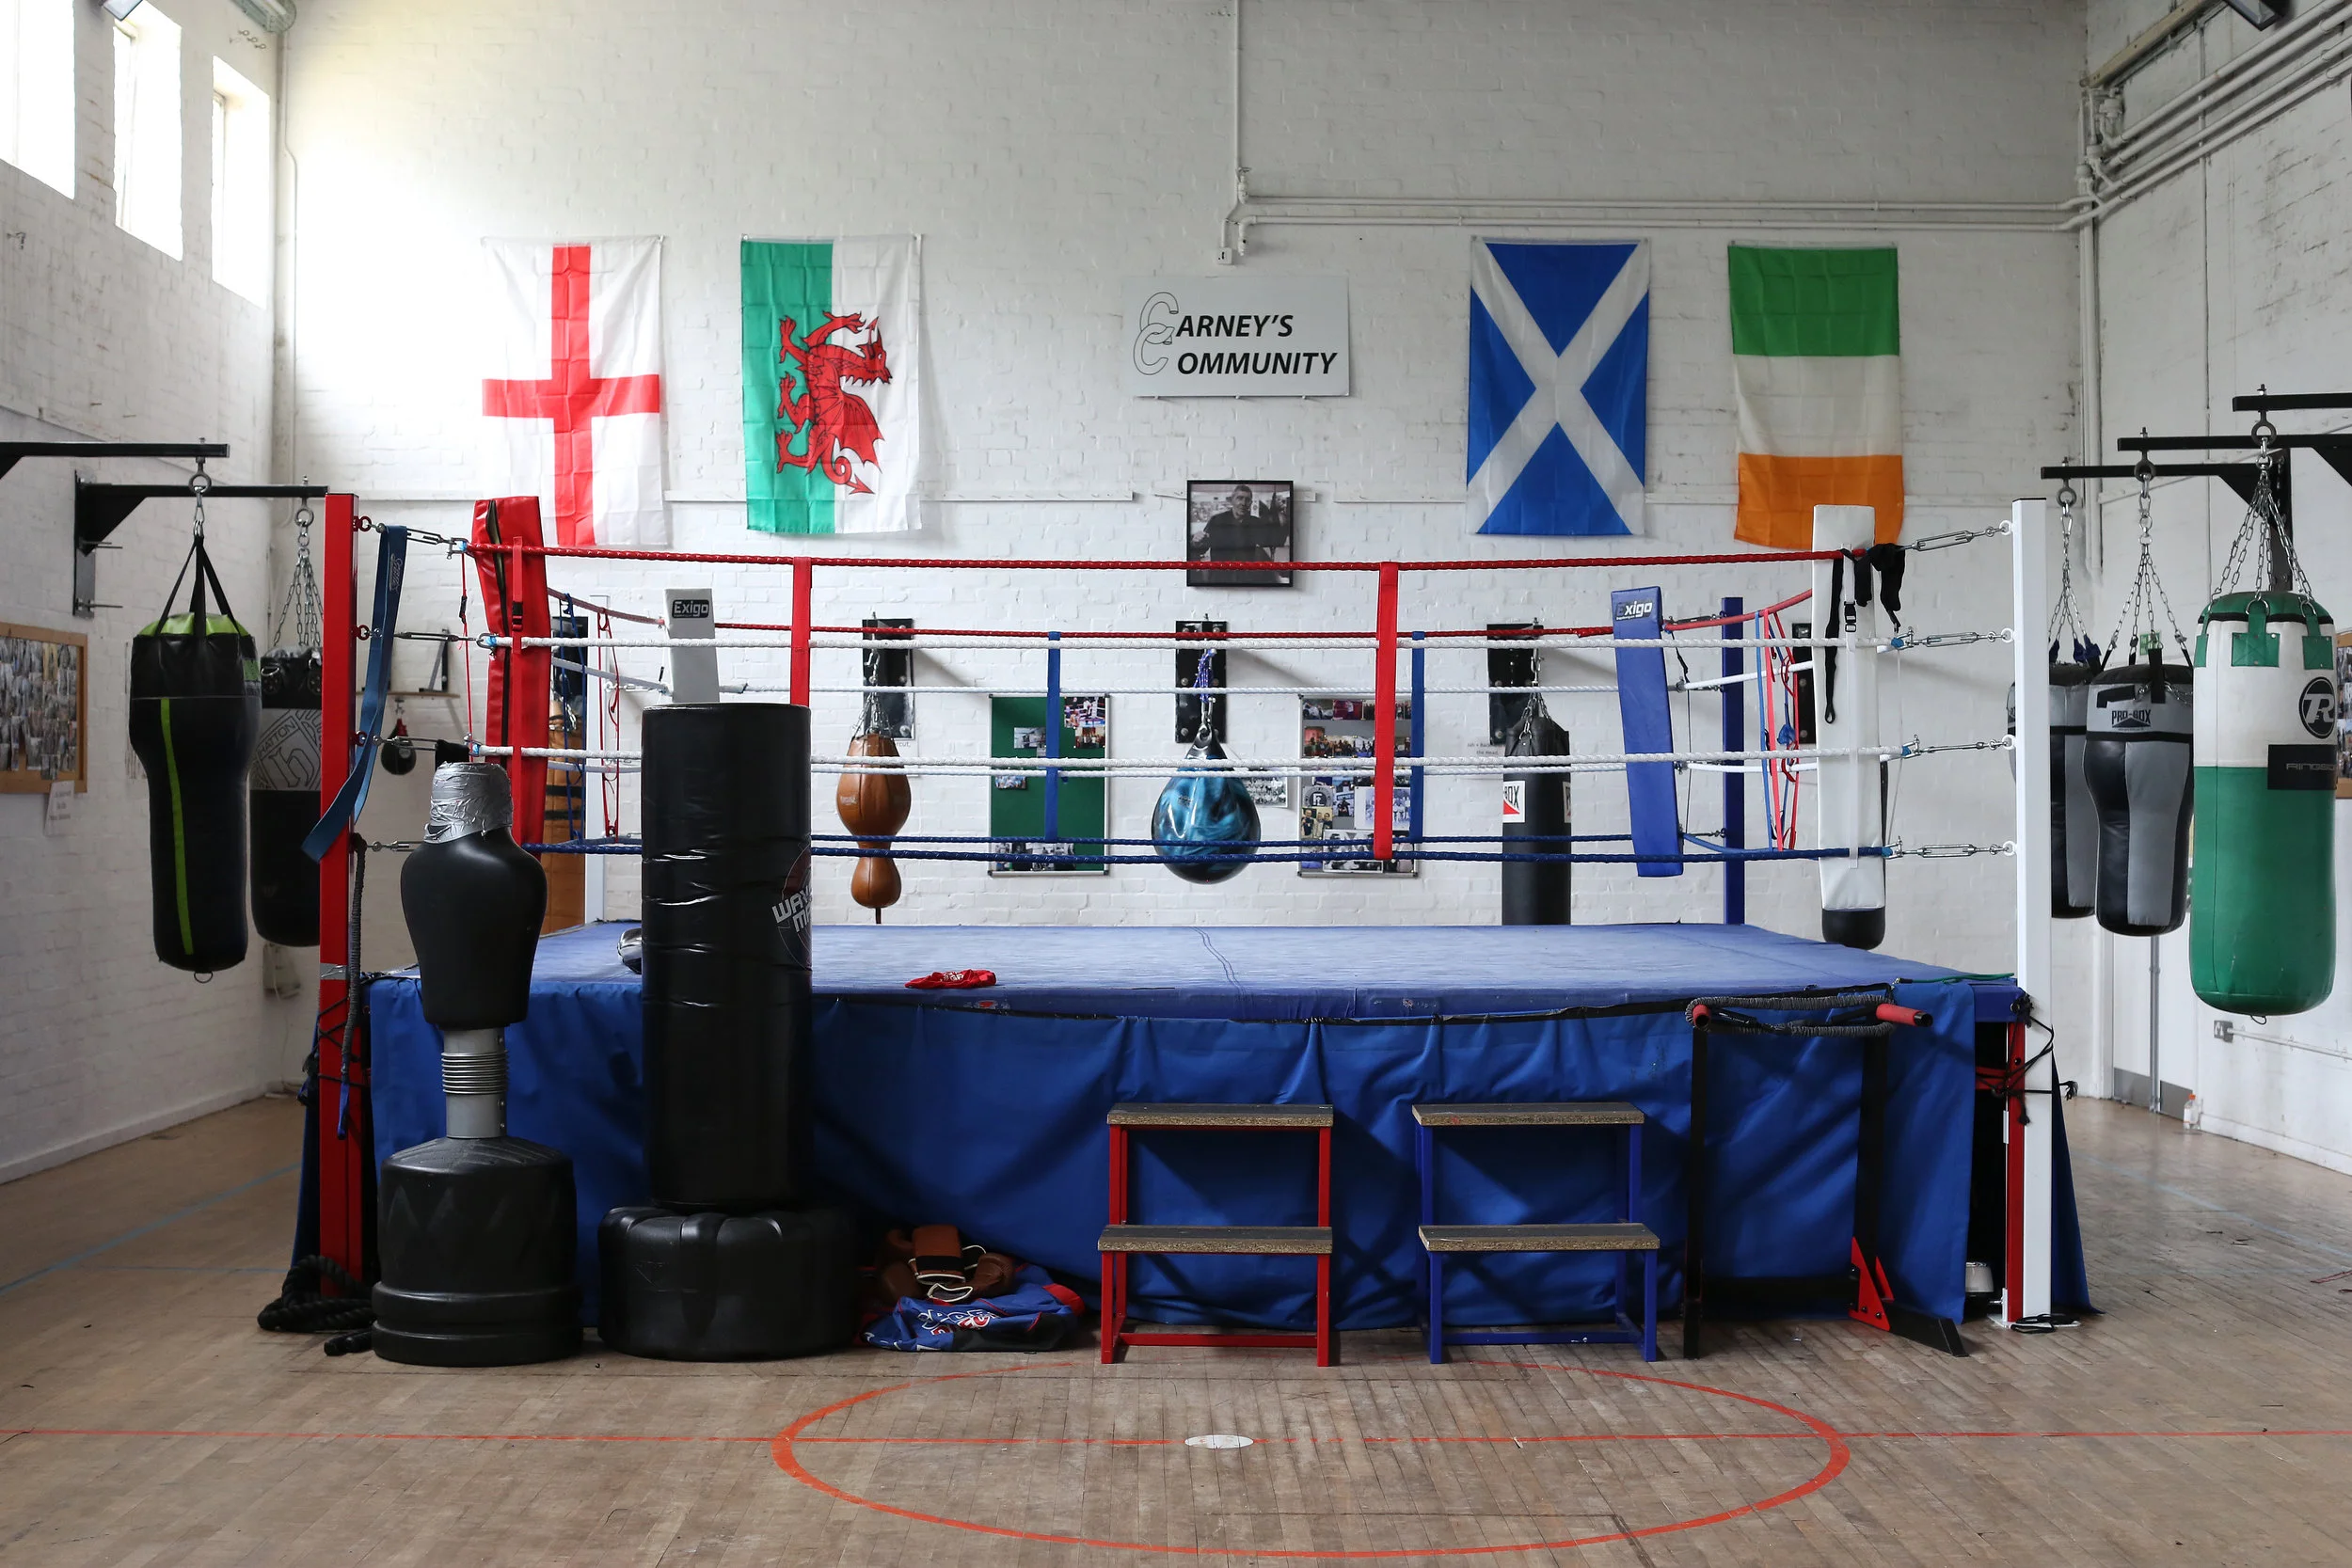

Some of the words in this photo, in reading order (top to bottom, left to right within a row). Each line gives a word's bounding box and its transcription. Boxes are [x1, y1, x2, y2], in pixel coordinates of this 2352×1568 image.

[674, 600, 708, 617] Exigo
[2111, 709, 2152, 725] PRO-BOX
[258, 720, 296, 755] HATTON
